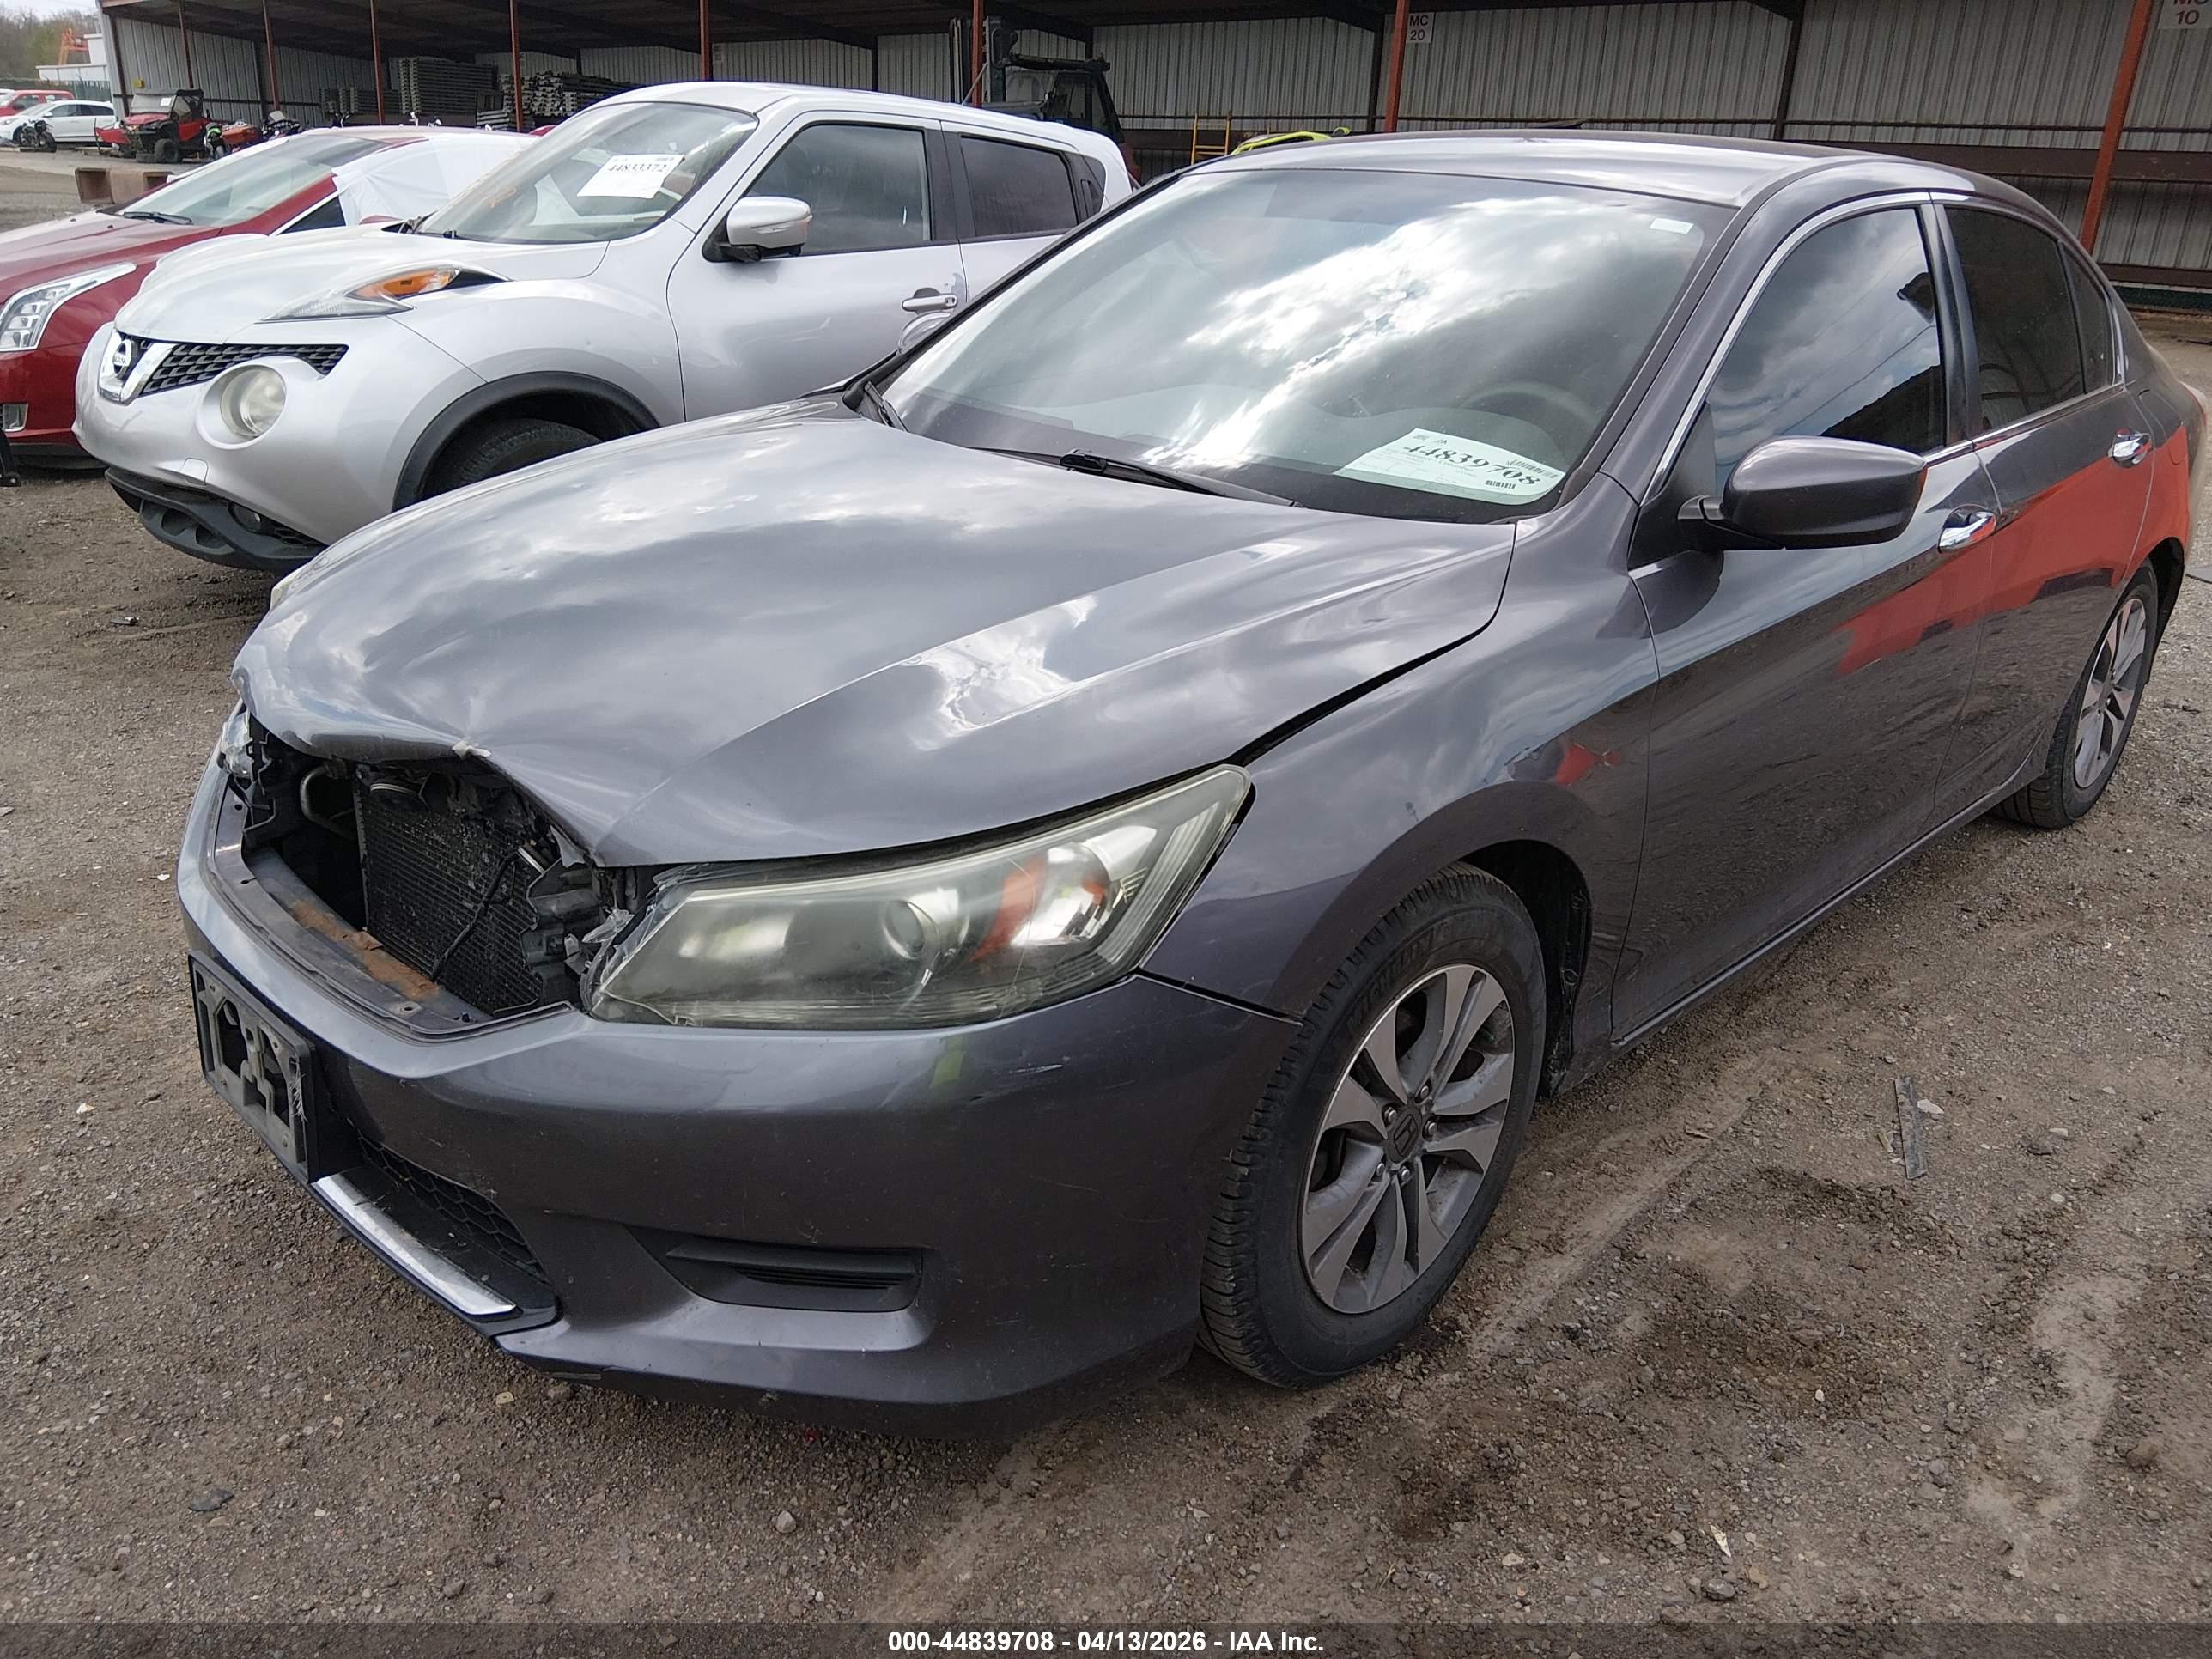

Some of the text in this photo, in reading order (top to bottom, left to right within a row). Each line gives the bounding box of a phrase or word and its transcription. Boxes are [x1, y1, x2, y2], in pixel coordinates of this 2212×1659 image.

[1409, 15, 1429, 26] MC
[2176, 9, 2200, 25] 10
[1409, 29, 1425, 41] 20
[1403, 444, 1541, 486] 44839708
